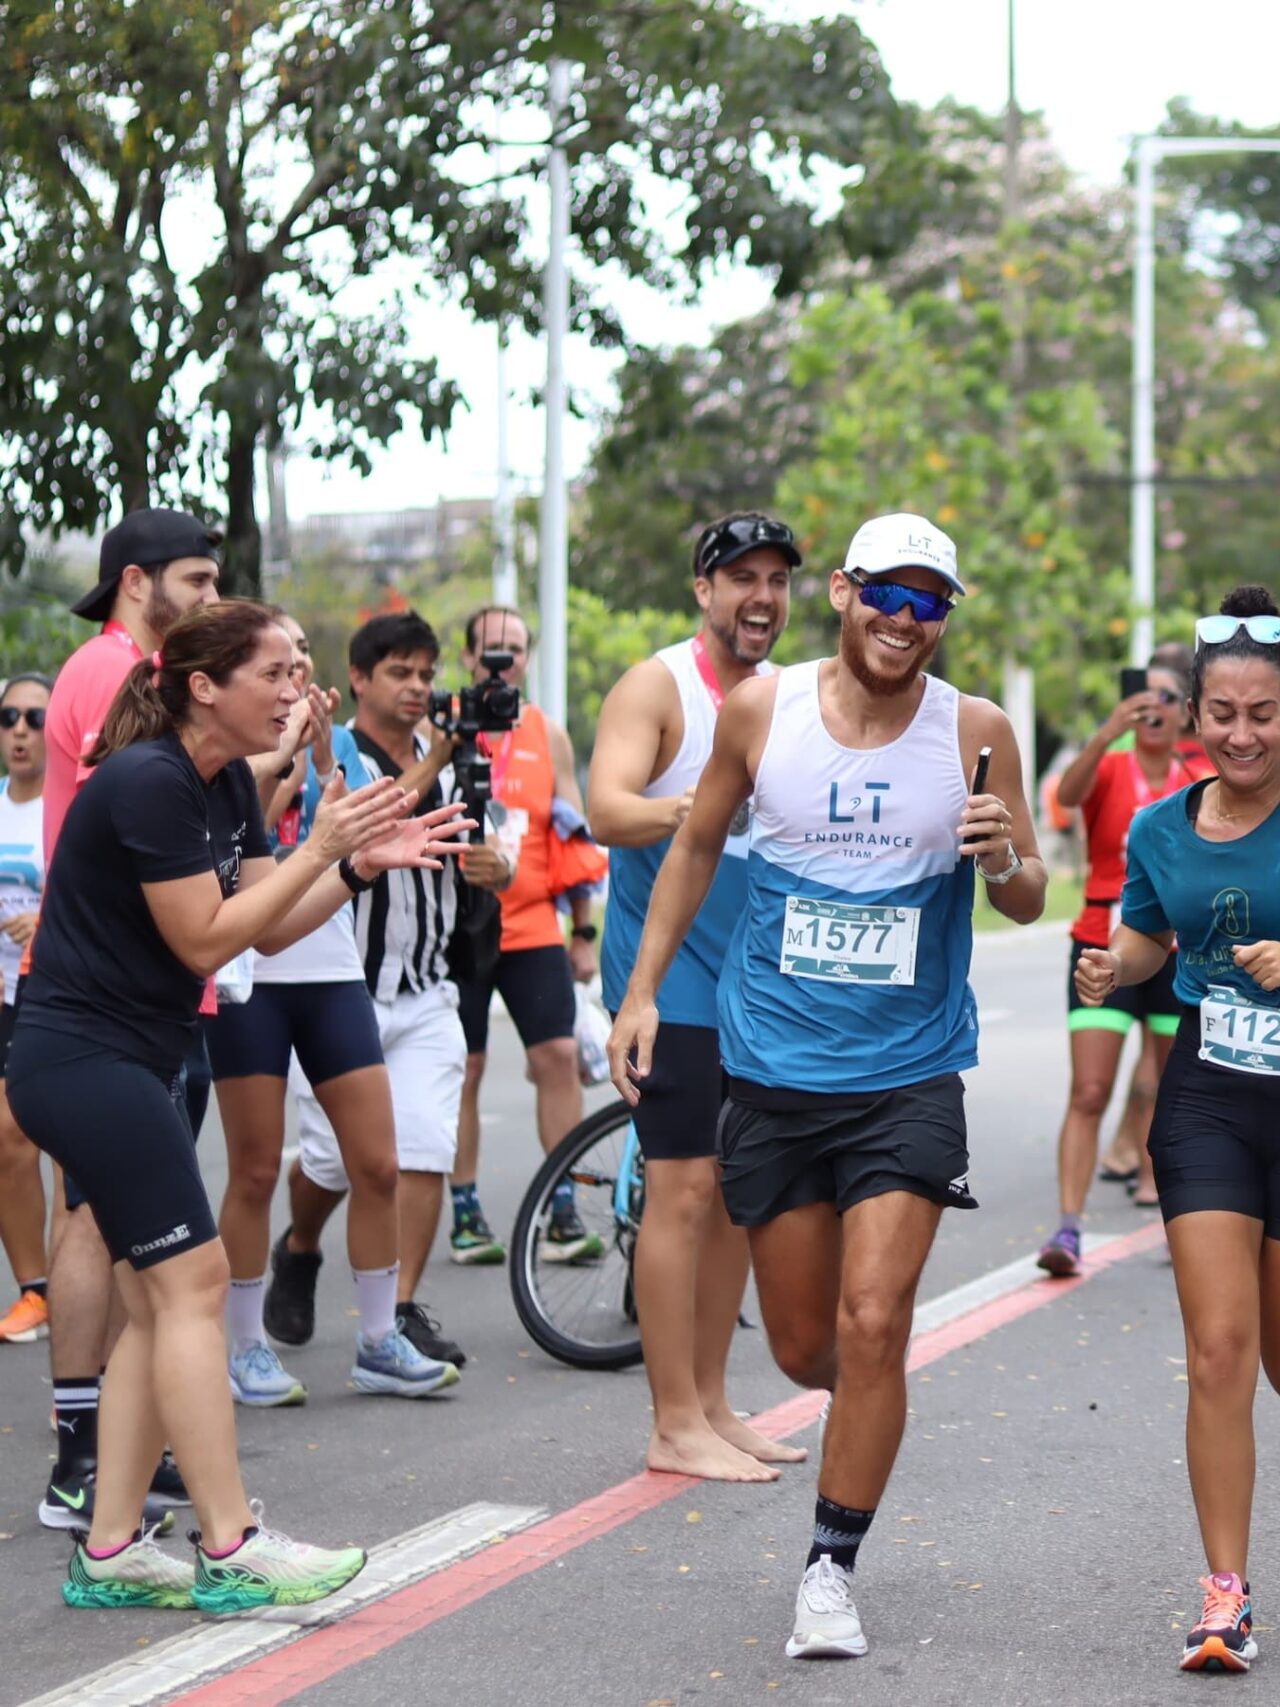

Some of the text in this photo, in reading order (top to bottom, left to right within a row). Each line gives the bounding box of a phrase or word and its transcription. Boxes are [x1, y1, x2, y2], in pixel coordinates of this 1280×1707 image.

[804, 832, 913, 848] ENDURANCE
[843, 849, 872, 859] TEAM
[786, 928, 804, 946] M
[806, 917, 892, 954] 1577
[1206, 1017, 1216, 1032] F
